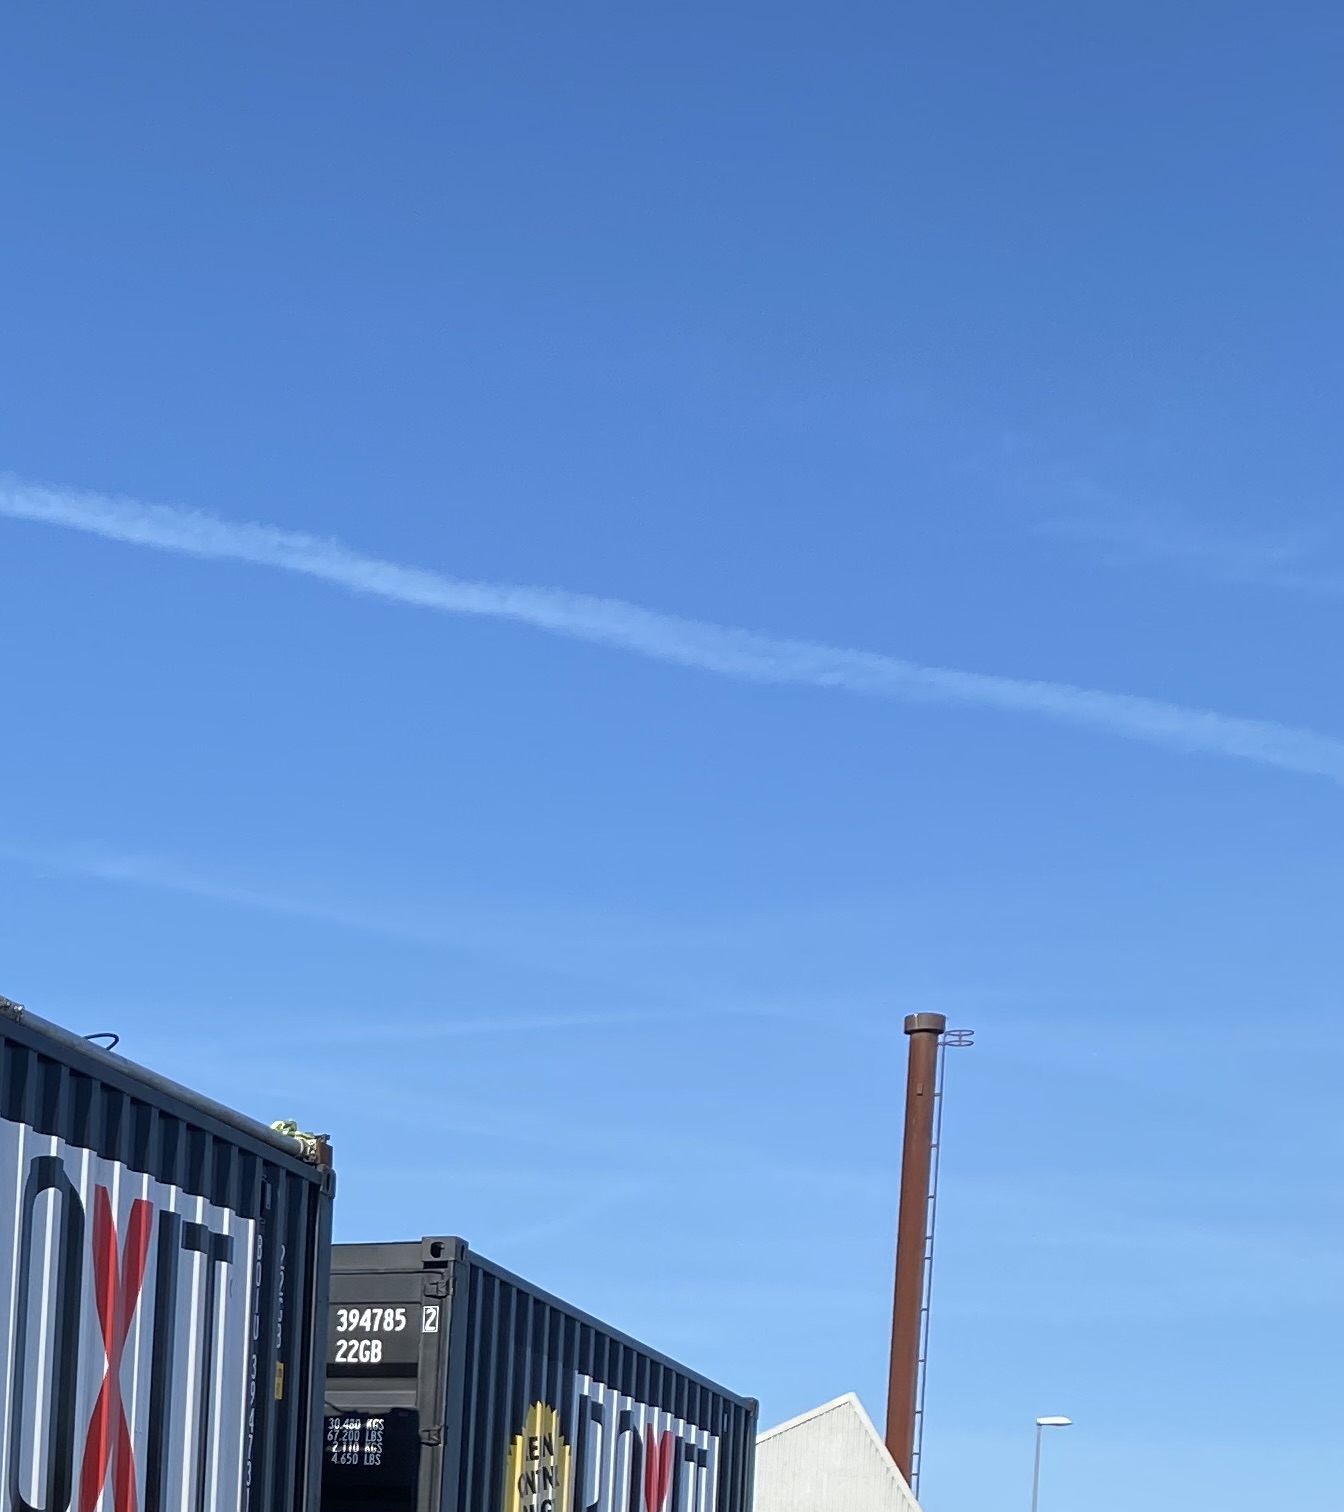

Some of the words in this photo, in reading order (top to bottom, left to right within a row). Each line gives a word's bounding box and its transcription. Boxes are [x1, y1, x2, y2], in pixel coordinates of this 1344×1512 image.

[336, 1308, 406, 1332] 394785
[424, 1306, 438, 1332] 2
[335, 1339, 382, 1363] 22GB
[365, 1430, 383, 1442] LBS
[363, 1453, 381, 1465] LBS
